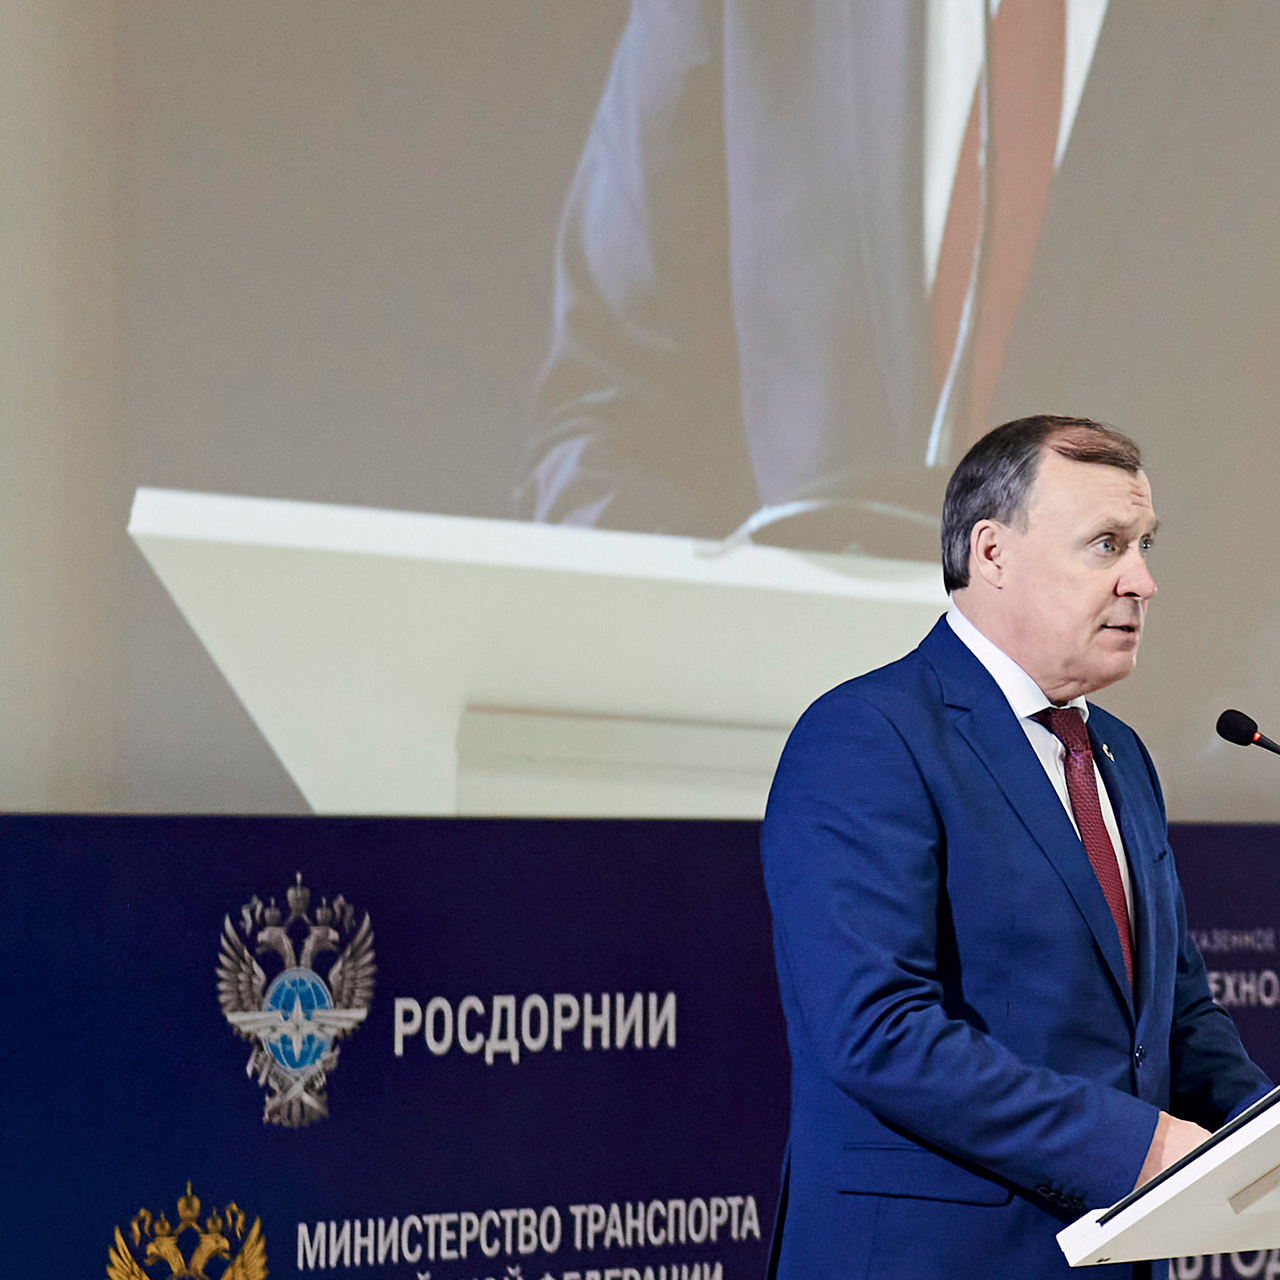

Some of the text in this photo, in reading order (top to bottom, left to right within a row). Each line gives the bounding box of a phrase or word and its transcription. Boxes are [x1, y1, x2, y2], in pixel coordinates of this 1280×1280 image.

[393, 991, 677, 1065] РОСДОРНИИ
[297, 1196, 761, 1271] МИНИСТЕРСТВО ТРАНСПОРТА
